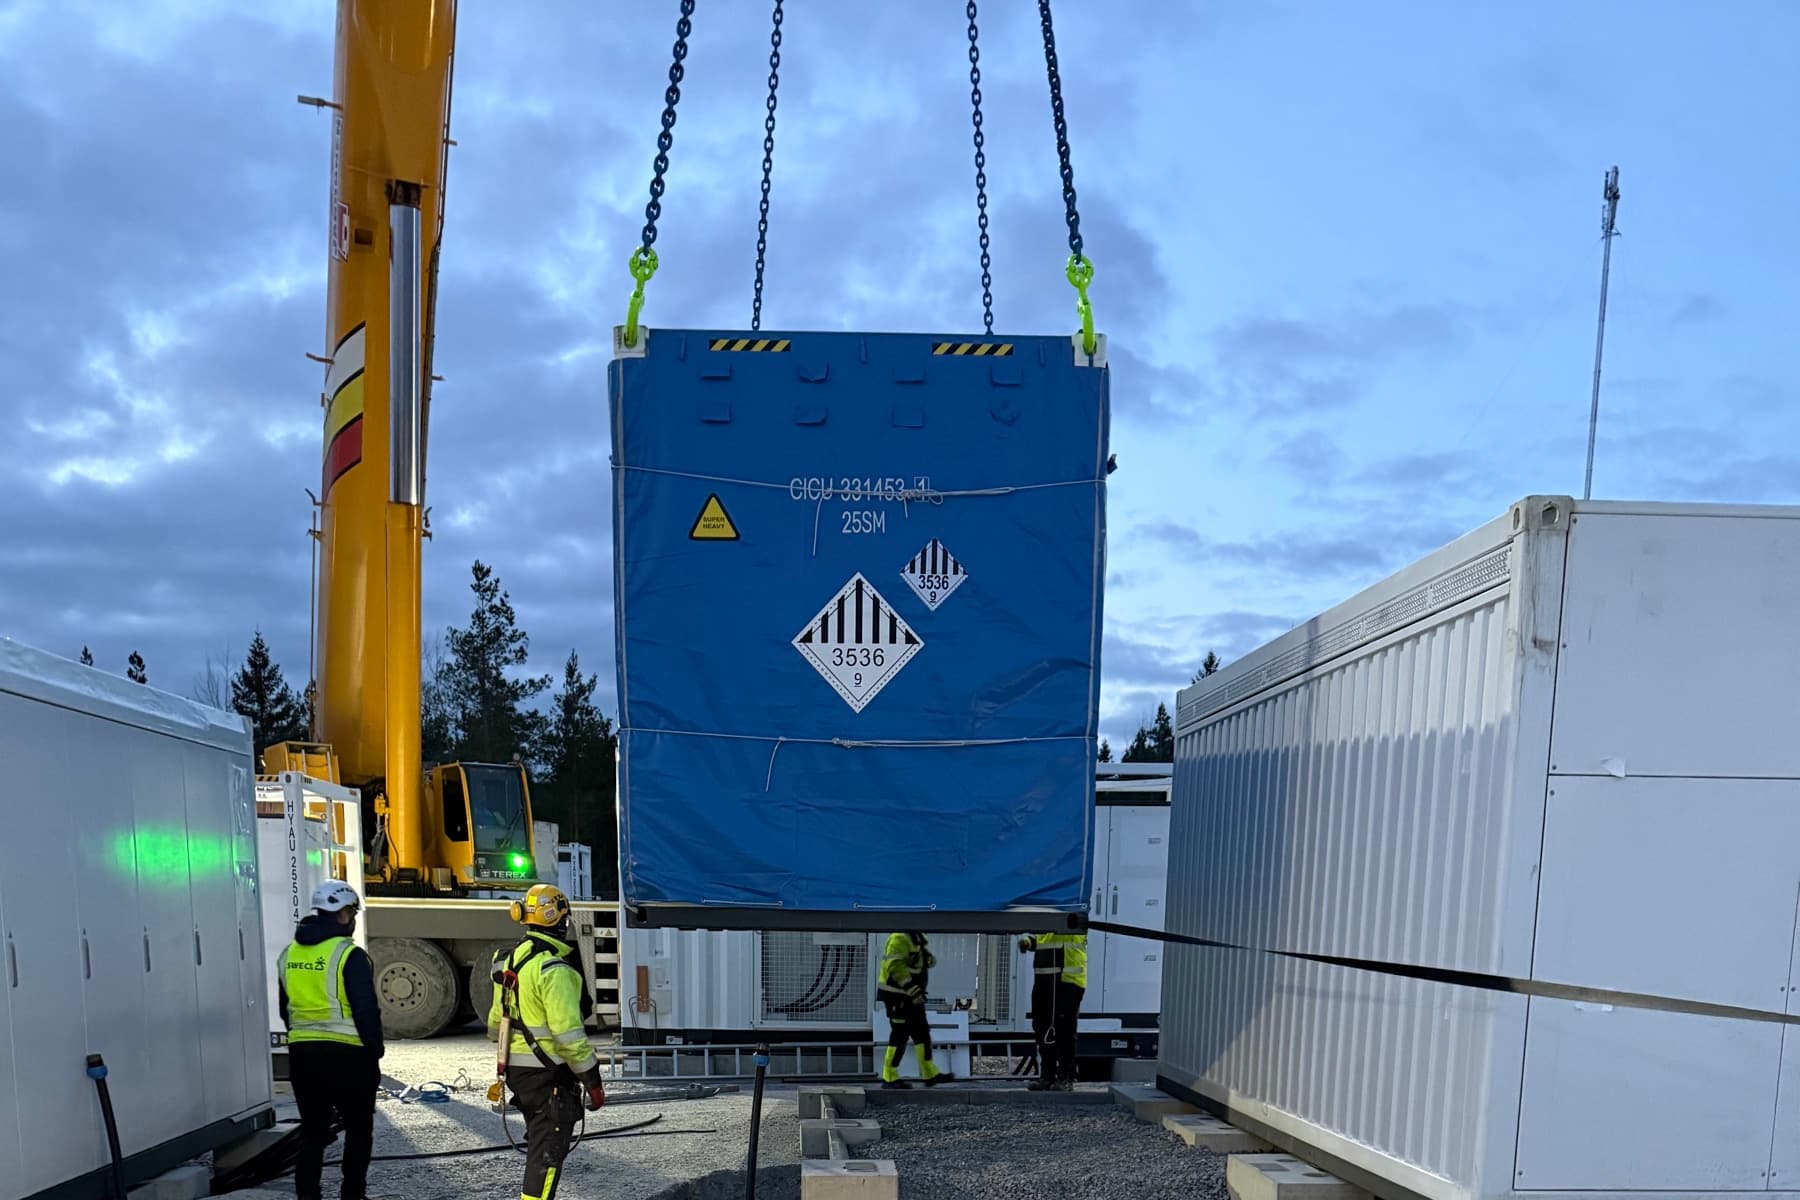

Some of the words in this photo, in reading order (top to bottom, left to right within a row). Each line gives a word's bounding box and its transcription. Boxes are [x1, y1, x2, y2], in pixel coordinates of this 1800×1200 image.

[790, 477, 833, 500] CICU
[840, 477, 905, 502] 331453
[842, 511, 886, 534] 25SM
[918, 575, 949, 590] 3536
[929, 591, 937, 601] 9
[832, 647, 885, 667] 3536
[854, 672, 862, 686] 9
[287, 801, 296, 852] HYAU
[491, 870, 527, 879] TEREX
[291, 856, 300, 925] 25504
